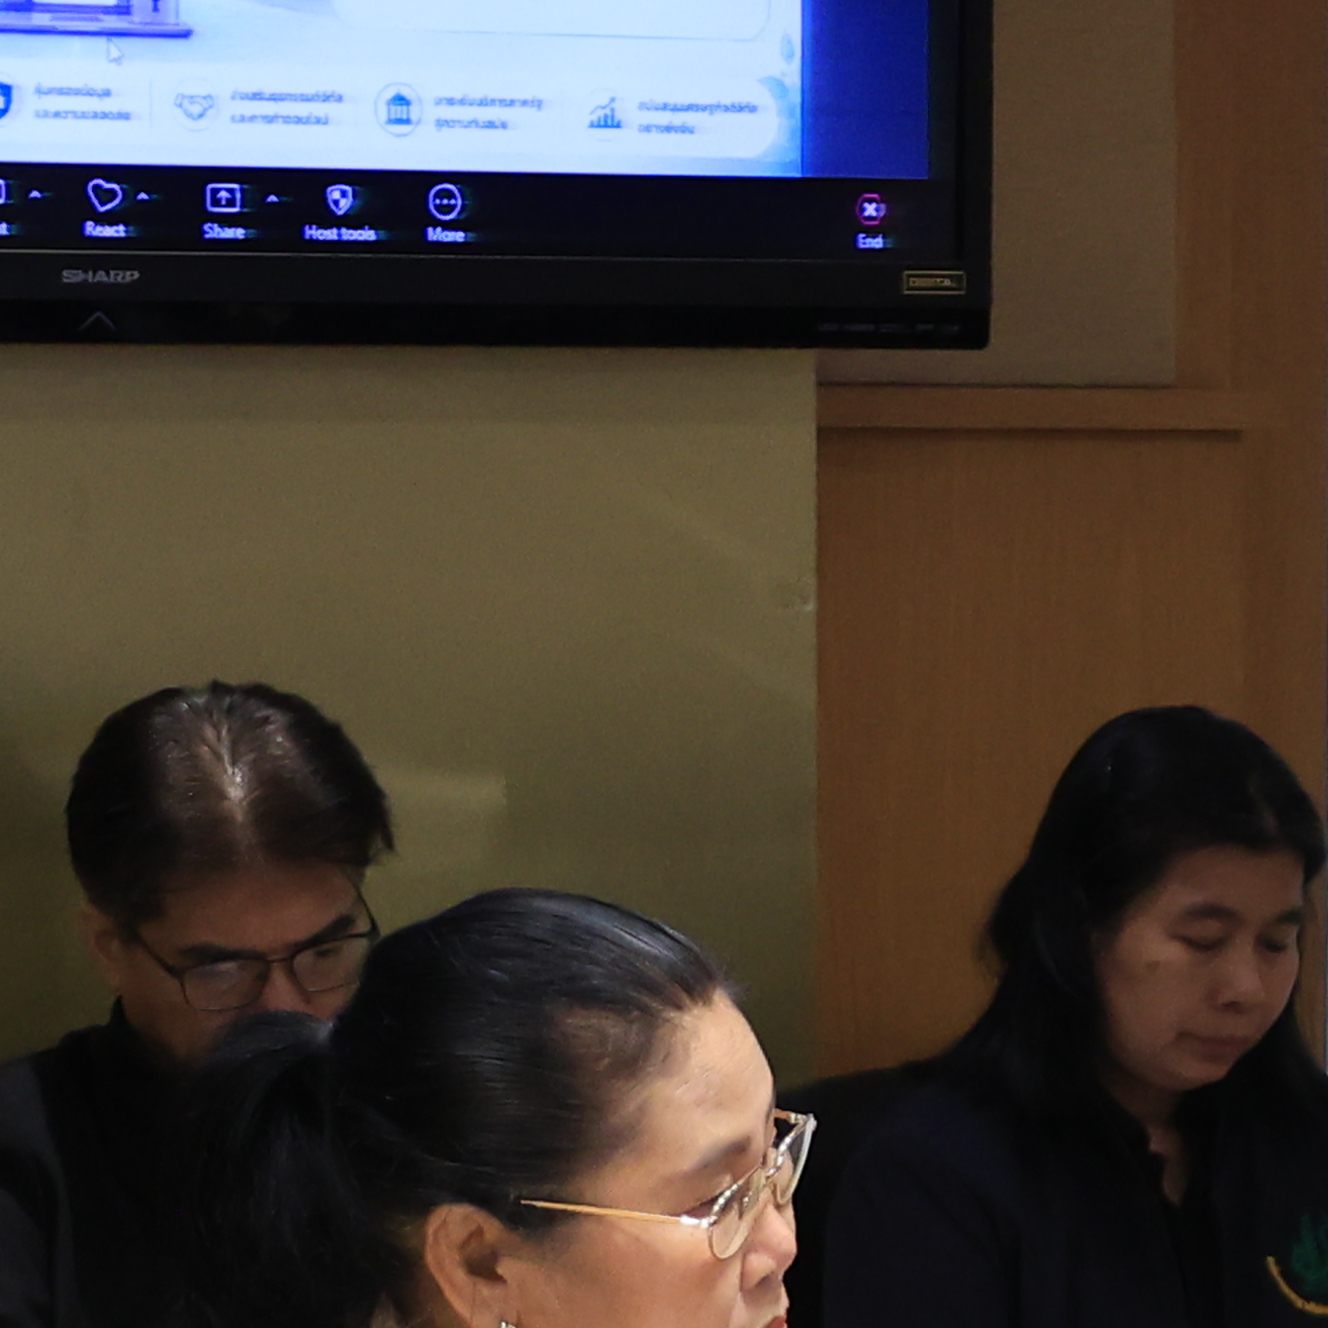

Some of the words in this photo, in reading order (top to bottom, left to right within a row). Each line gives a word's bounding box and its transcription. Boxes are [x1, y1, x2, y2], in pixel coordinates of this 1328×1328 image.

[84, 221, 125, 237] React
[203, 222, 246, 239] Share
[304, 223, 336, 240] Host
[340, 224, 376, 241] tools
[427, 226, 464, 242] More
[857, 232, 884, 249] End
[61, 269, 140, 283] SHARP
